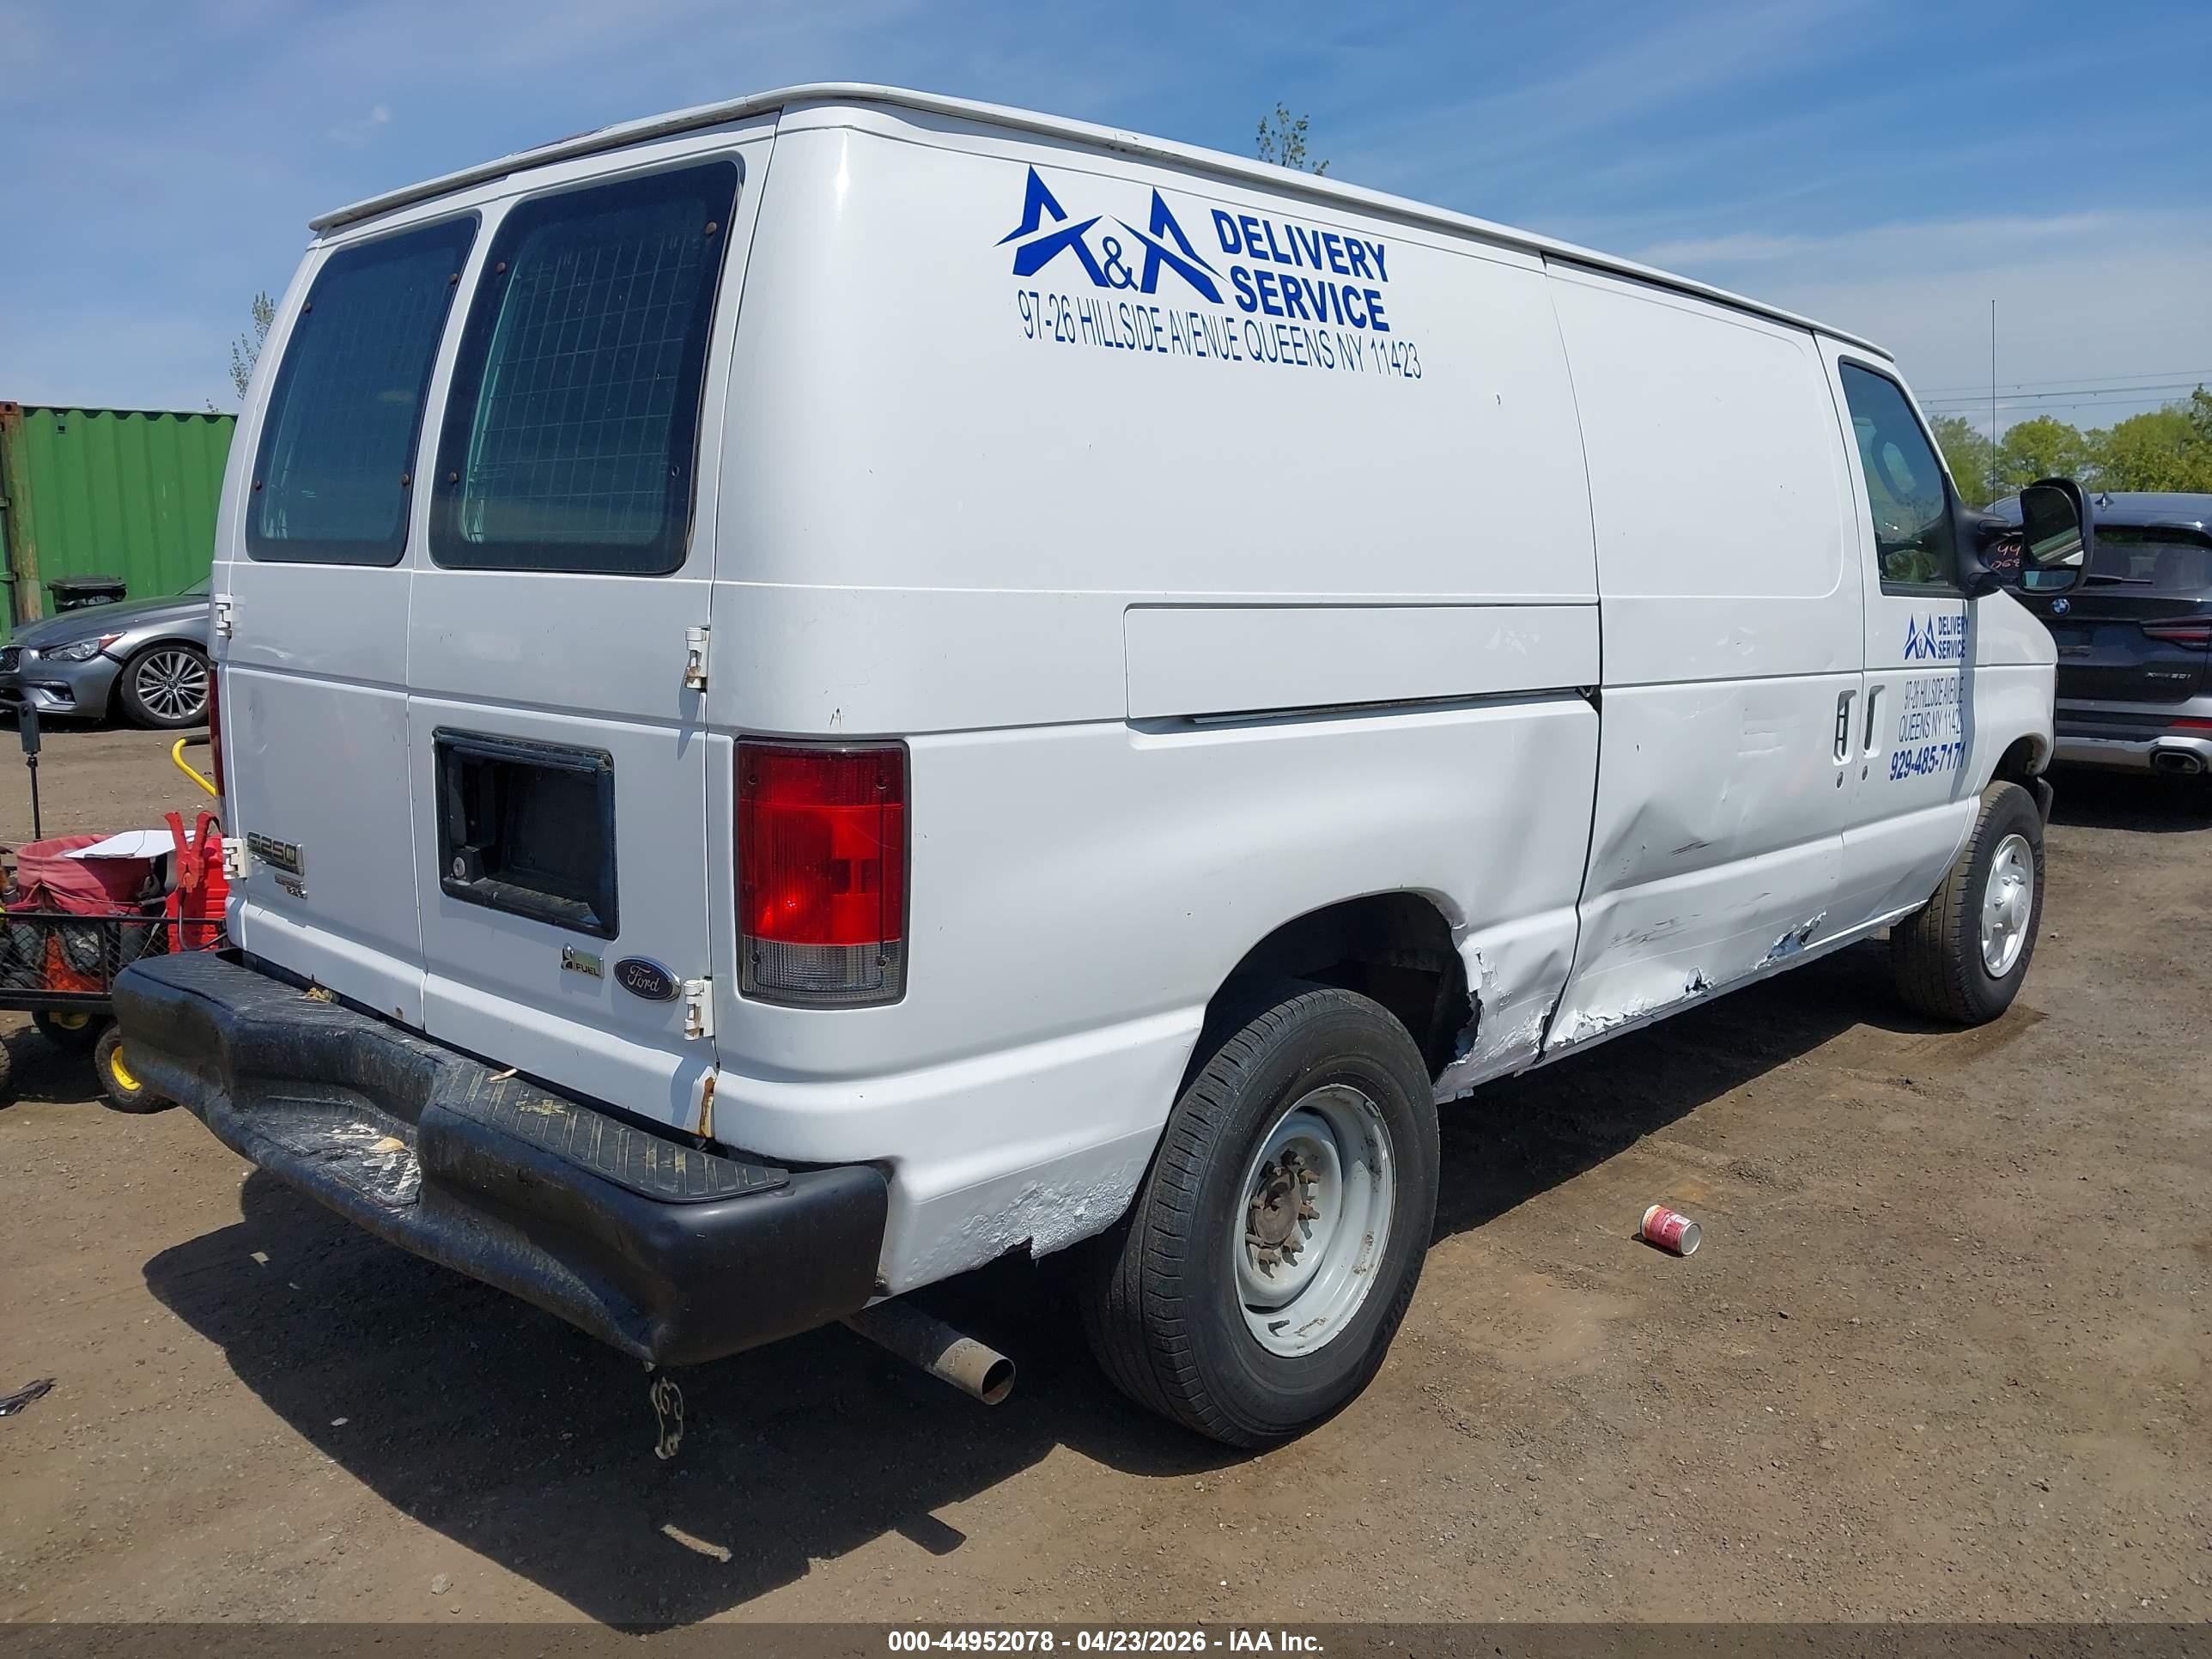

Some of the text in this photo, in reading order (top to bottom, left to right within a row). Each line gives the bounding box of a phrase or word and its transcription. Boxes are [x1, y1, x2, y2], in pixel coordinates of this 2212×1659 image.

[994, 164, 1228, 304] A&A
[1211, 209, 1389, 282] DELIVERY
[1230, 265, 1390, 332] SERVICE
[1018, 290, 1422, 379] 97-26 HILLSIDE AVENUE QUEENS NY 11423
[1938, 616, 1969, 636] DELIVERY
[1938, 639, 1966, 659] SERVICE
[1899, 712, 1931, 743] QUEENS
[1931, 709, 1942, 737] NY
[1890, 741, 1966, 781] 929-485-7171
[575, 963, 599, 976] FUEL
[627, 963, 660, 993] Ford
